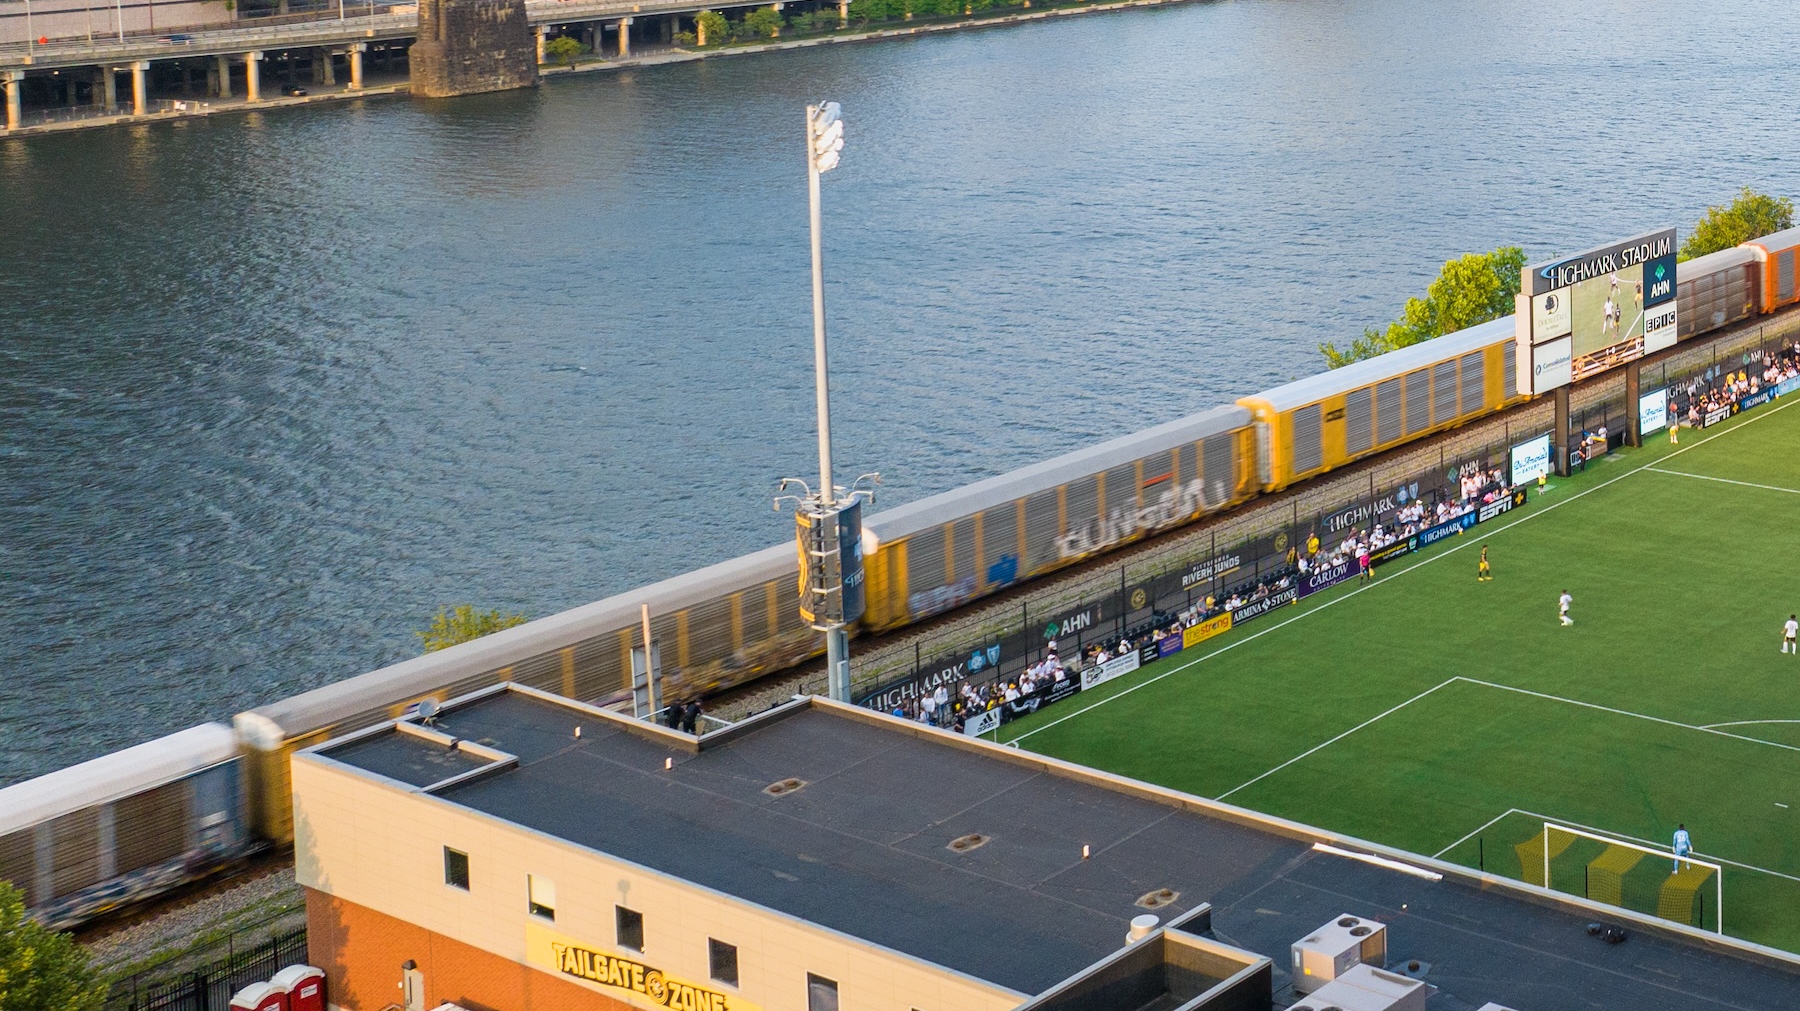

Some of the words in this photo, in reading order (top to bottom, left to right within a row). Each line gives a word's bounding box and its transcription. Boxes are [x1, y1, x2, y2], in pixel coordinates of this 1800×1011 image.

[1550, 252, 1618, 290] HIGHMARK
[1621, 237, 1671, 268] STADIUM
[1651, 279, 1671, 299] AHN
[1646, 311, 1675, 333] EPIC
[1750, 351, 1764, 363] AHN
[1705, 405, 1730, 427] ESPN
[1459, 460, 1479, 476] AHN
[1522, 464, 1540, 474] EATERY
[1330, 495, 1395, 532] HIGHMARK
[1479, 496, 1512, 522] ESPN
[1424, 521, 1461, 543] HIGHMARK
[1182, 556, 1240, 587] RIVERHOUNDS
[1309, 563, 1349, 588] CARLOW
[1233, 604, 1262, 622] ARMINA
[1271, 589, 1297, 606] STONE
[1060, 610, 1091, 637] AHN
[869, 663, 965, 711] HIGHMARK
[552, 942, 647, 994] TAILGATE
[668, 980, 727, 1011] ZONE
